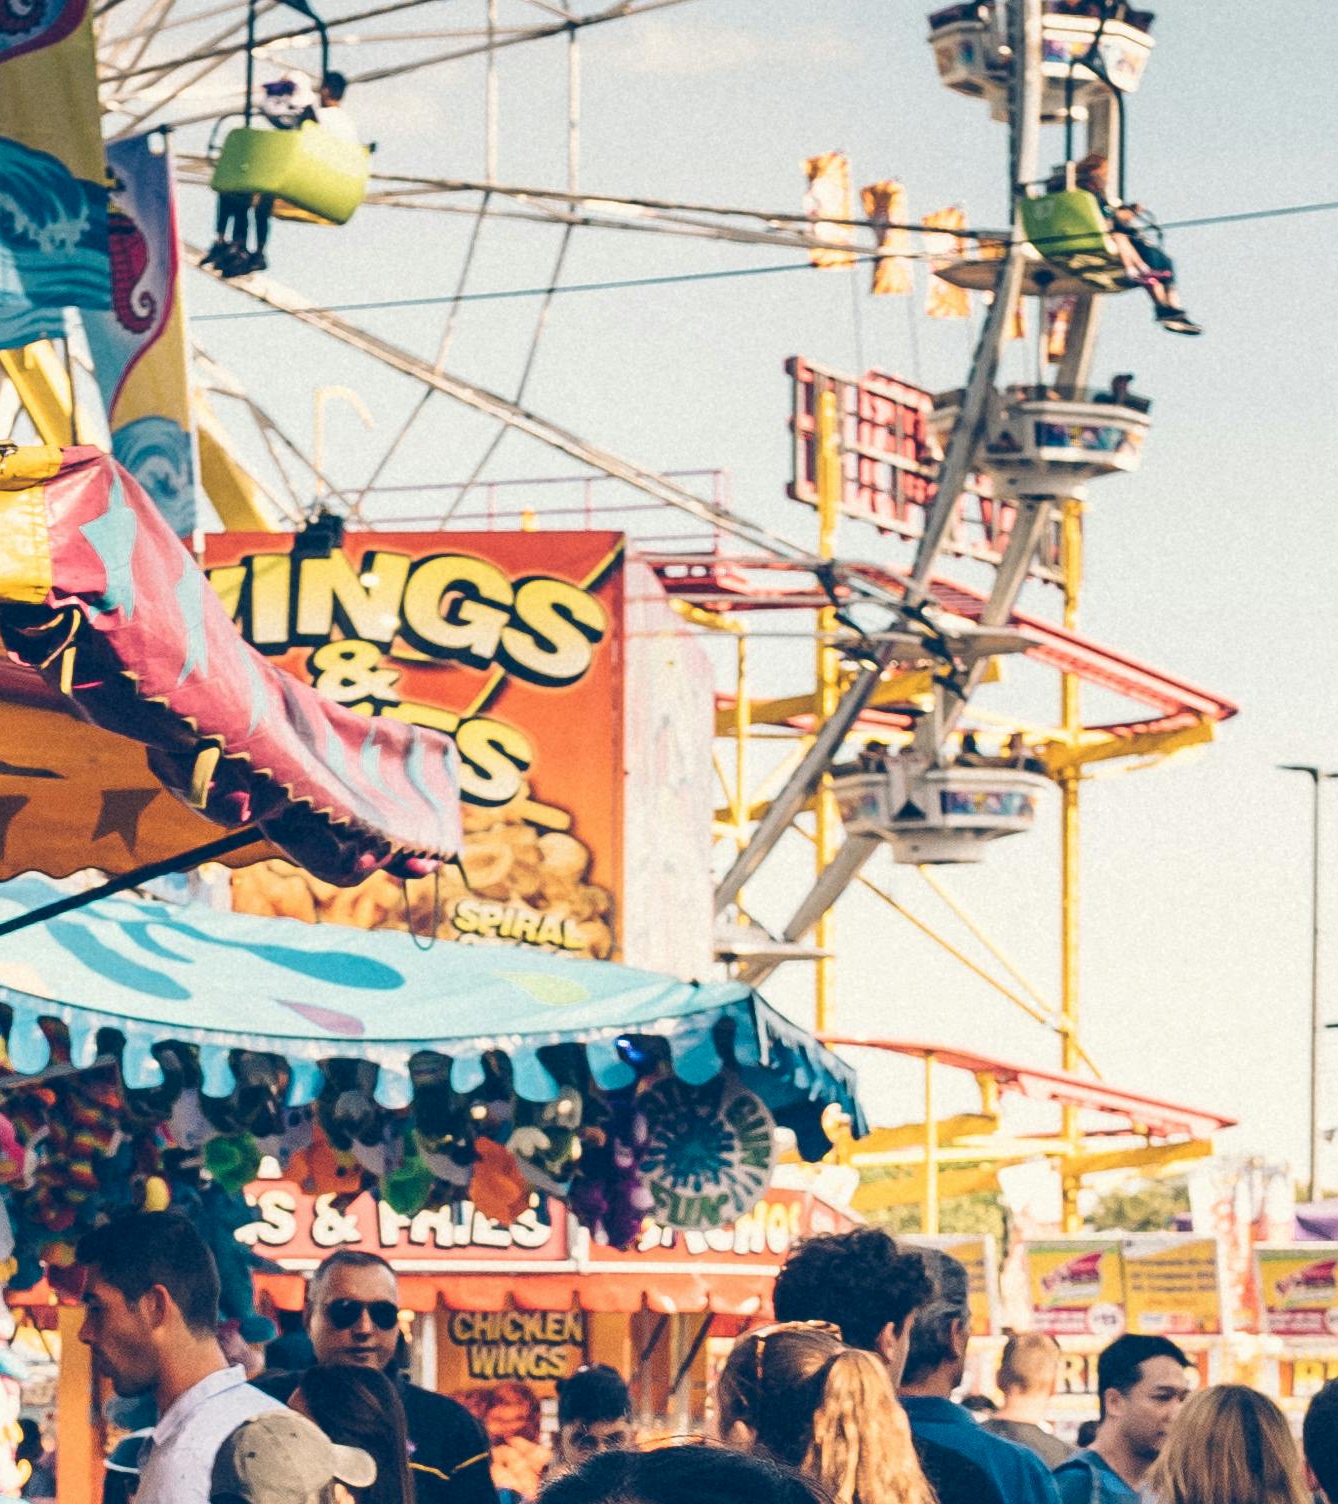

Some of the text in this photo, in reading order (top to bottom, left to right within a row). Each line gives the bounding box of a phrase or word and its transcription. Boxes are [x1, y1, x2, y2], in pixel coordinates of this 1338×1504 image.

[311, 639, 401, 704] &
[453, 898, 586, 952] SPIRAL
[311, 1191, 363, 1248] &
[448, 1309, 581, 1345] CHICKEN
[468, 1345, 566, 1380] WINGS
